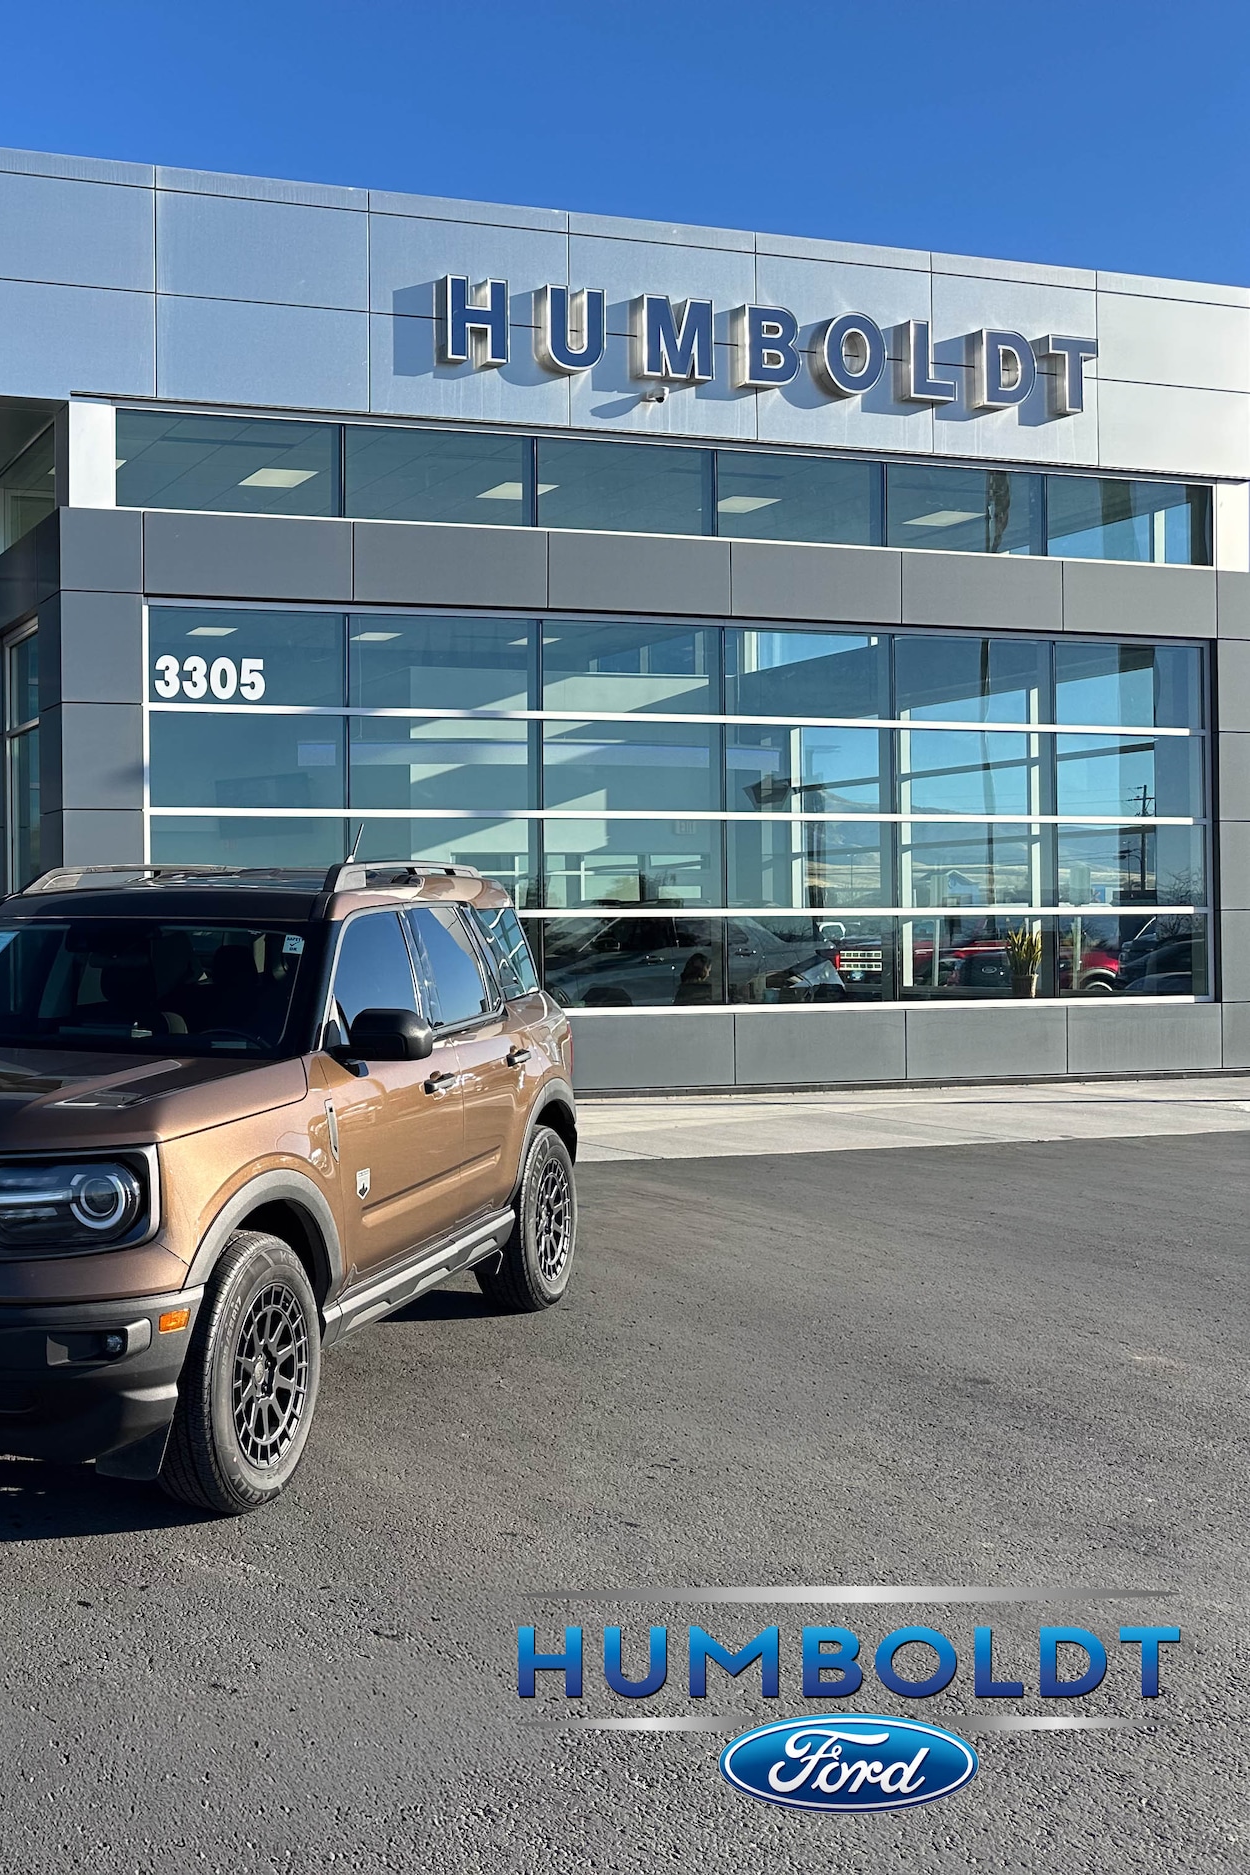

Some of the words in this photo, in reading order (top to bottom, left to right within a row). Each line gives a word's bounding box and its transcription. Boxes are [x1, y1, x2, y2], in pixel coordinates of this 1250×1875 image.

[443, 273, 1099, 416] HUMBOLDT
[154, 654, 266, 701] 3305
[230, 1473, 271, 1504] KELLY
